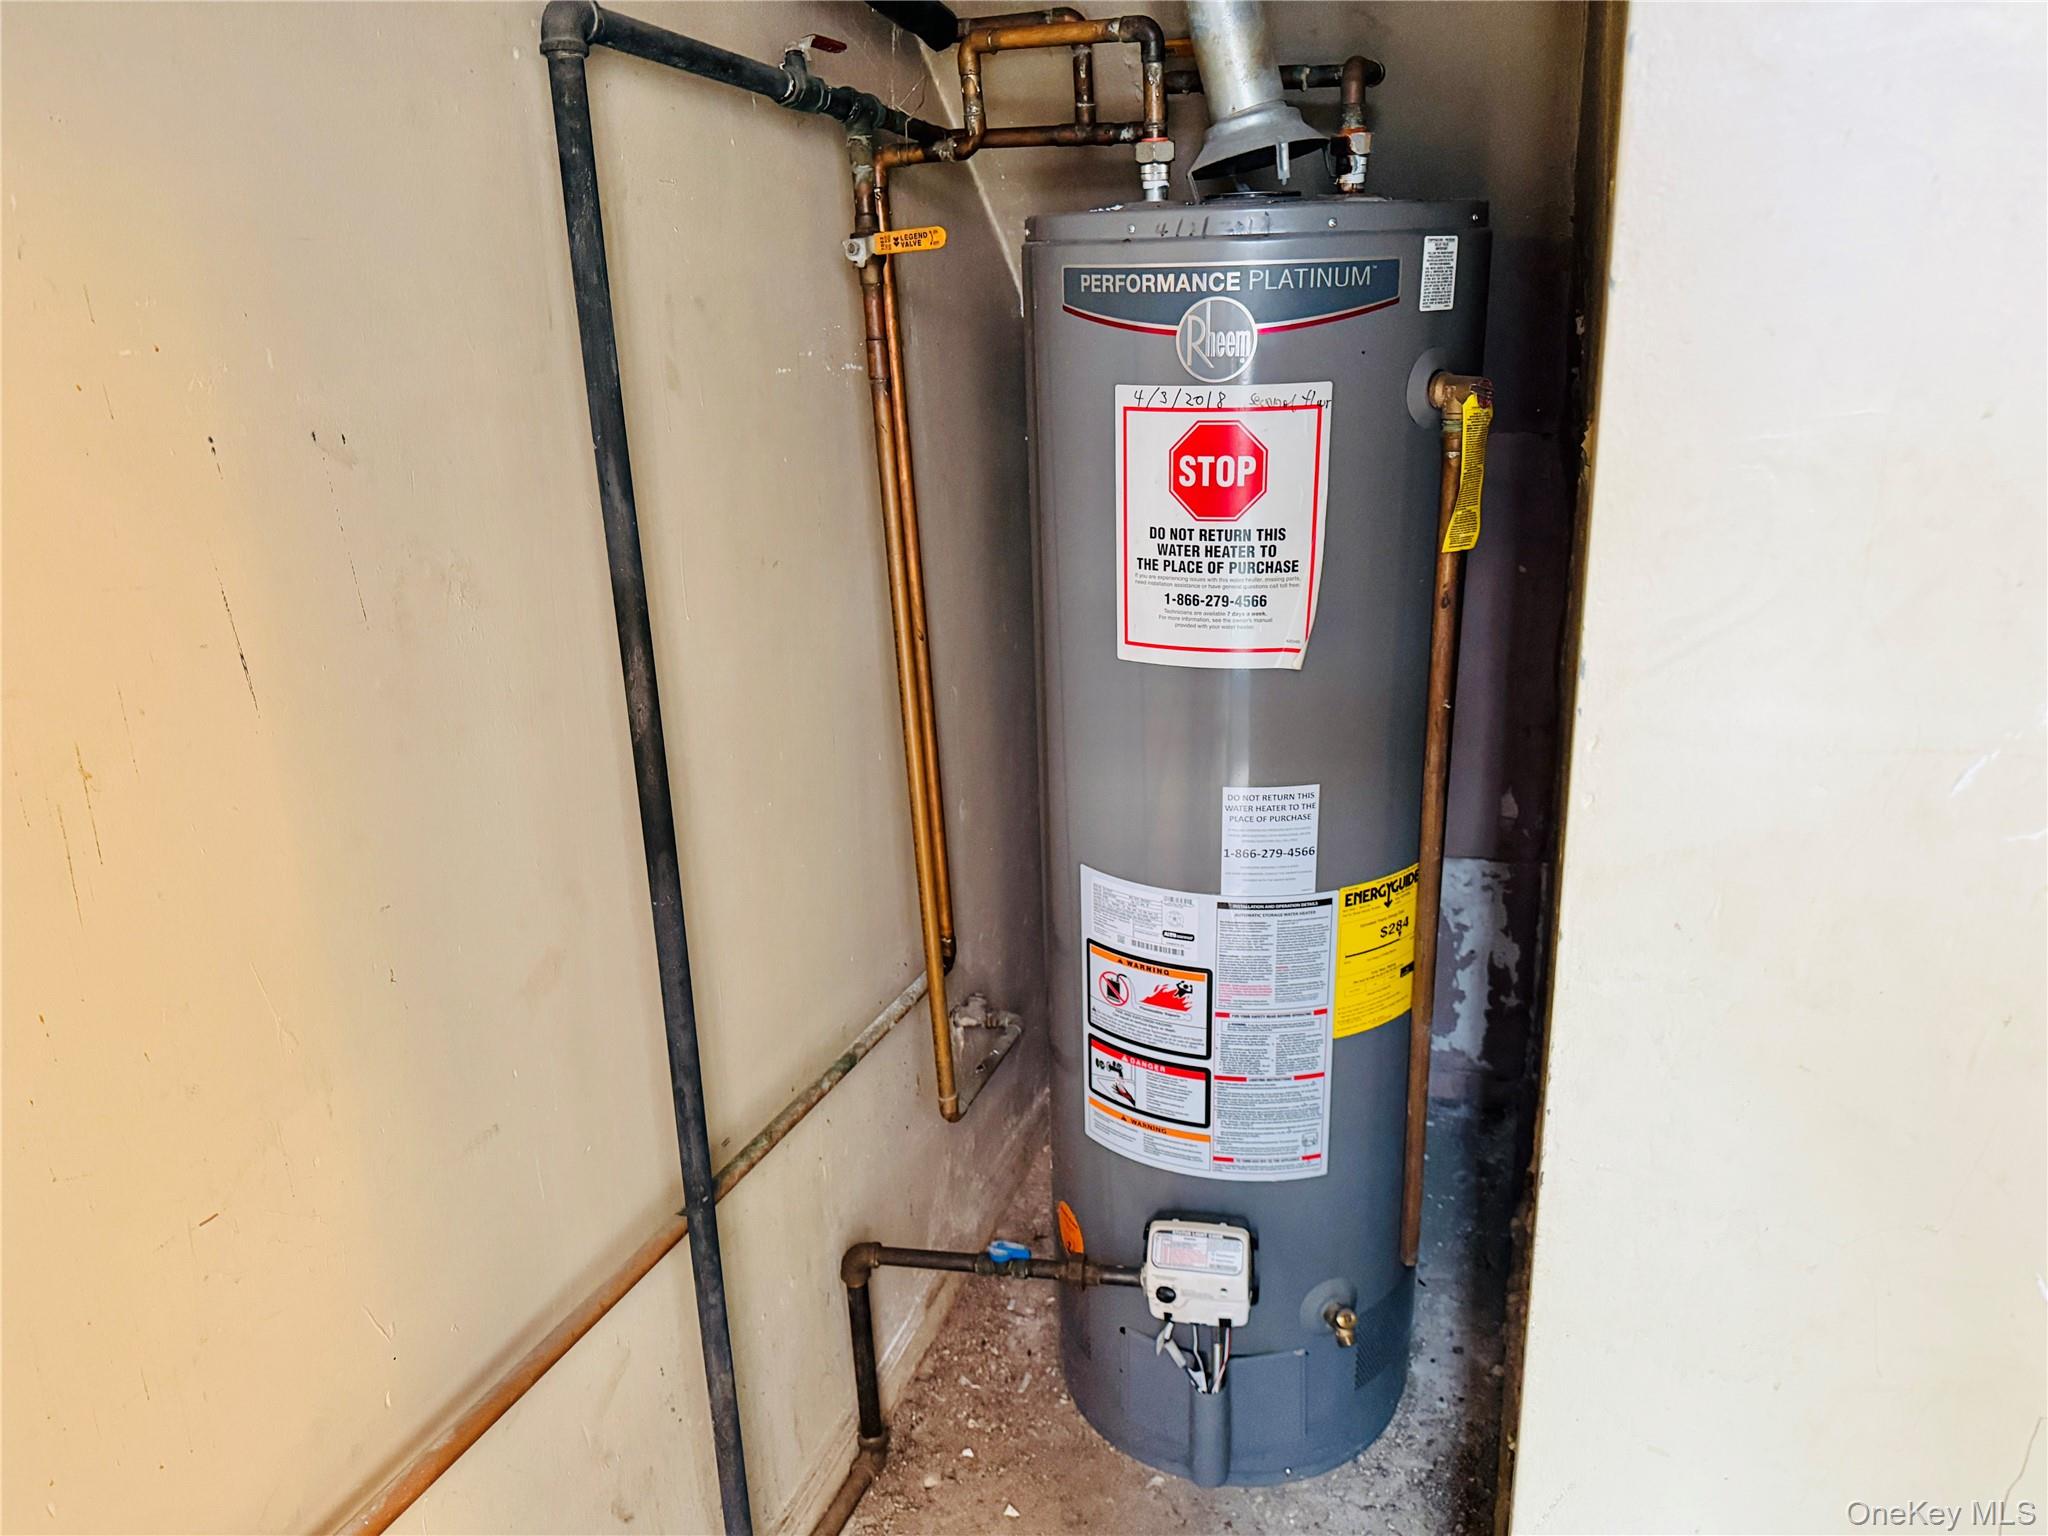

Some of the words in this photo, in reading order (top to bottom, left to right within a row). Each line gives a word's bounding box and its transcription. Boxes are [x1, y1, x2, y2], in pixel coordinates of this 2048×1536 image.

[900, 231, 928, 241] LEGEND
[900, 239, 922, 248] VALVE
[1080, 271, 1241, 294] PERFORMANCE
[1187, 301, 1251, 369] Rheem
[1134, 386, 1227, 409] 4/3/2018
[1178, 455, 1258, 488] STOP
[1149, 526, 1166, 541] DO
[1169, 527, 1195, 542] NOT
[1199, 528, 1252, 543] RETURN
[1256, 527, 1287, 542] THIS
[1157, 543, 1201, 558] WATER
[1204, 544, 1256, 559] HEATER
[1260, 544, 1277, 558] TO
[1136, 557, 1159, 572] THE
[1163, 559, 1204, 574] PLACE
[1207, 561, 1225, 575] OF
[1229, 559, 1300, 575] PURCHASE
[1164, 592, 1268, 608] 1-866-279-4566
[1227, 793, 1240, 802] DO
[1242, 793, 1260, 802] NOT
[1262, 792, 1296, 801] RETURN
[1297, 791, 1315, 800] THIS
[1224, 804, 1254, 813] WATER
[1255, 803, 1287, 812] HEATER
[1288, 803, 1300, 811] TO
[1301, 802, 1317, 810] THE
[1229, 814, 1255, 823] PLACE
[1256, 814, 1268, 823] OF
[1269, 813, 1313, 822] PURCHASE
[1223, 846, 1316, 859] 1-866-279-4566
[1344, 868, 1420, 908] ENERGYGUIDE
[1126, 961, 1171, 976] WARNING
[1130, 1058, 1167, 1074] DANGER
[1130, 1118, 1168, 1135] WARNING
